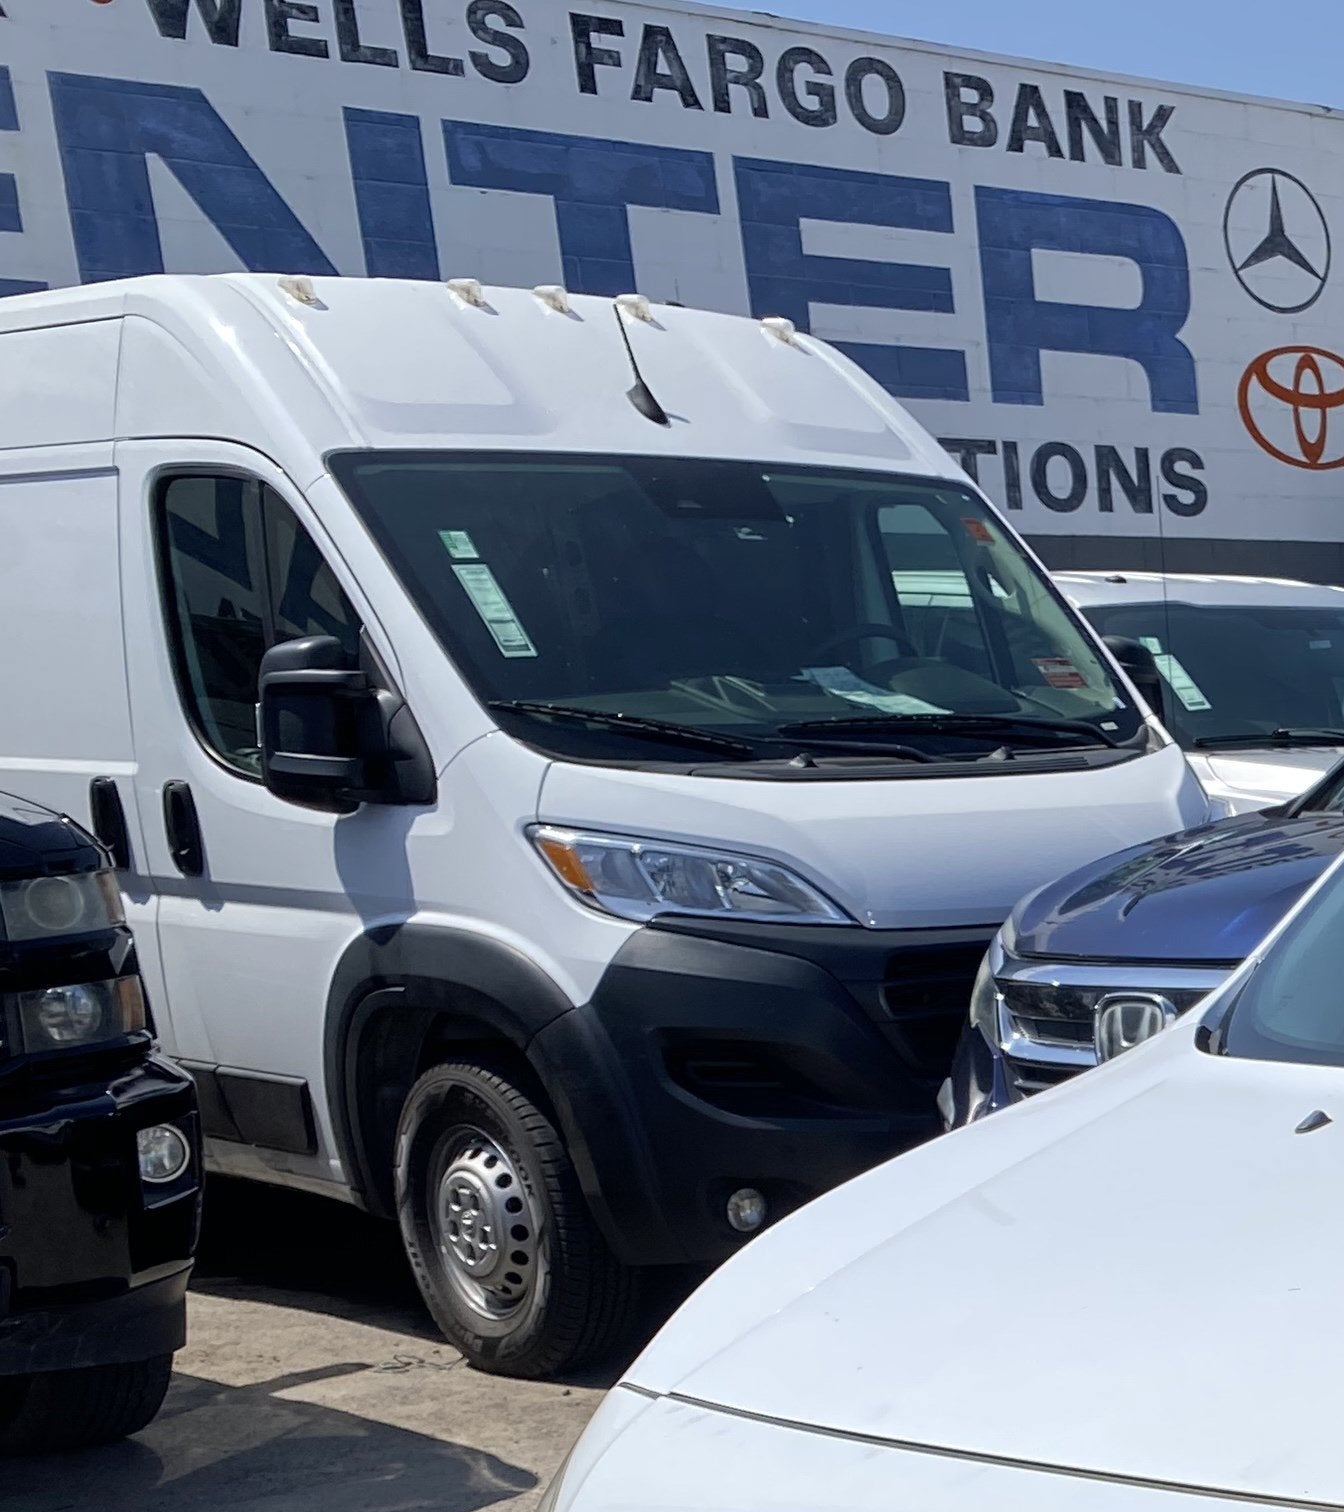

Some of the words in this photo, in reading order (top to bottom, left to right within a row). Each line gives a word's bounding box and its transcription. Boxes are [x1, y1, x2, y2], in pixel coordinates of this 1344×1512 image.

[145, 0, 531, 85] WELLS
[568, 11, 907, 136] FARGO
[943, 70, 1183, 175] BANK
[0, 65, 1200, 415] NTER
